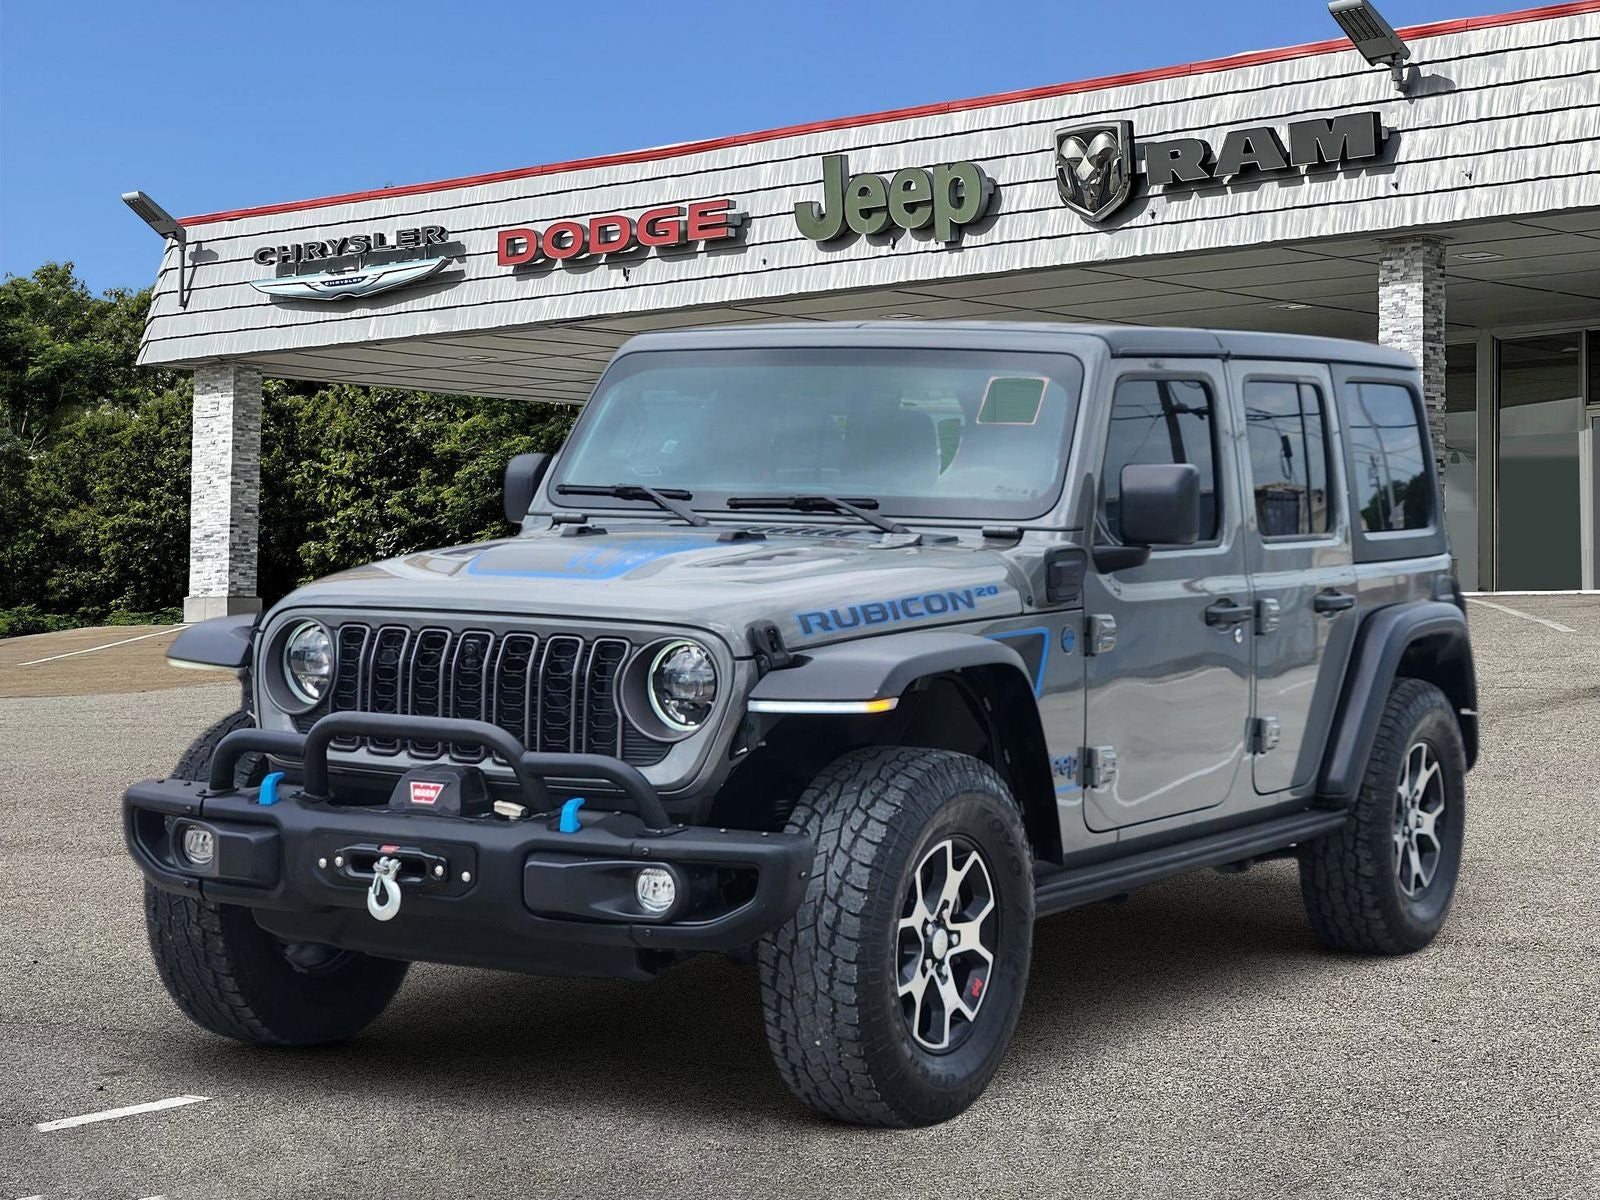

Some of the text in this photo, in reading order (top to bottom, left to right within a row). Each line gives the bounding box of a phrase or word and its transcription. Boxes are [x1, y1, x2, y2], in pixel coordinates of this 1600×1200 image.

[1145, 112, 1380, 185] RAM
[794, 155, 984, 242] Jeep
[253, 225, 449, 266] CHRYSLER
[498, 199, 736, 266] DODGE
[324, 277, 363, 287] CHRYSLER
[798, 590, 976, 635] RUBICON
